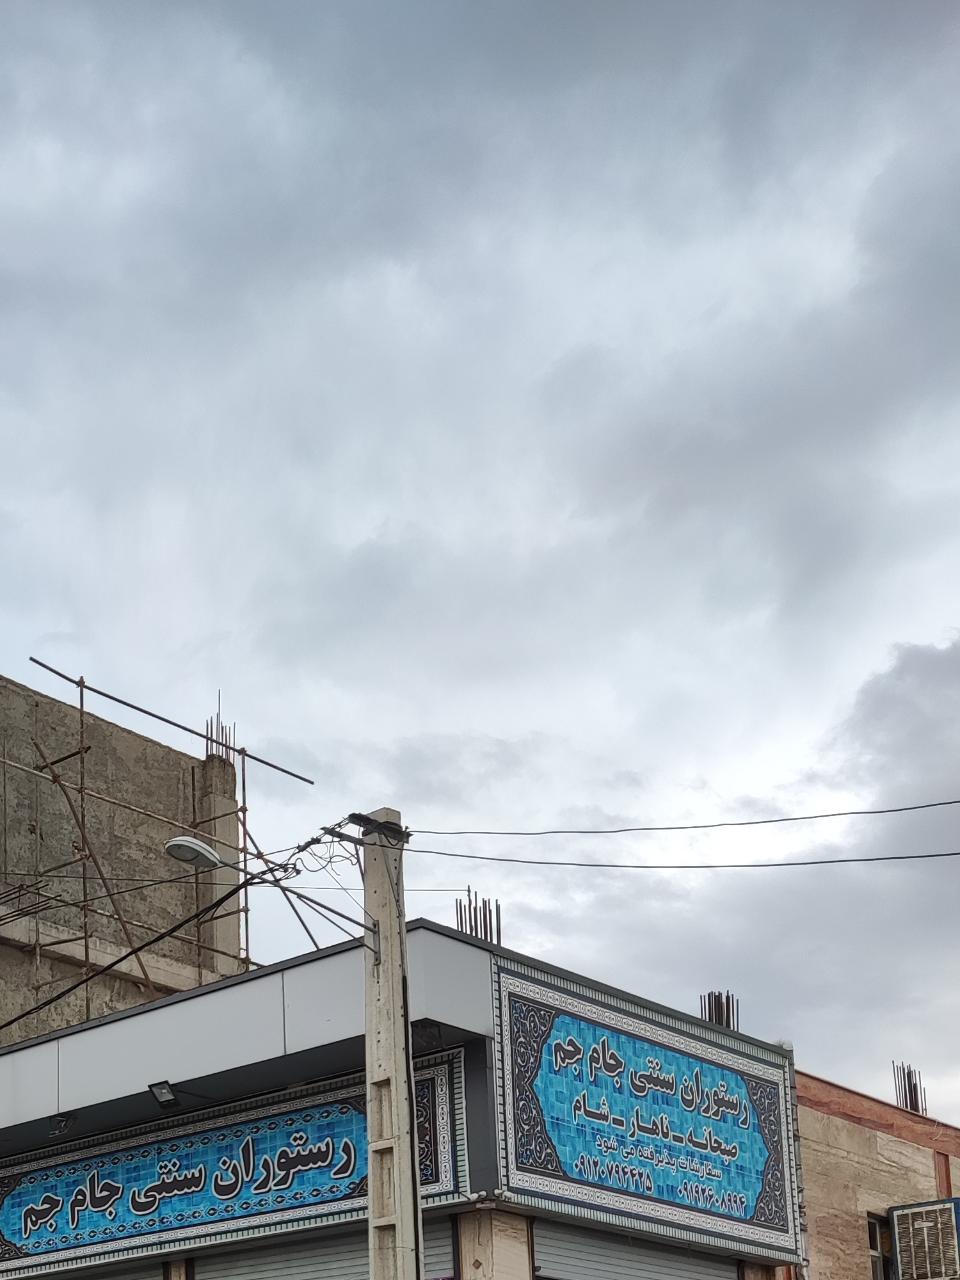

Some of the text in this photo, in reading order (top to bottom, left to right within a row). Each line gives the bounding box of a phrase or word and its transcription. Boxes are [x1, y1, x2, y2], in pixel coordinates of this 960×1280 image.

[552, 1035, 751, 1129] رستوران سنتی جام جم
[572, 1091, 738, 1165] صبحانه ناهار شام
[595, 1135, 722, 1180] سفارشات پذیرفته می شود
[22, 1131, 356, 1239] رستوران سنتی جام جم
